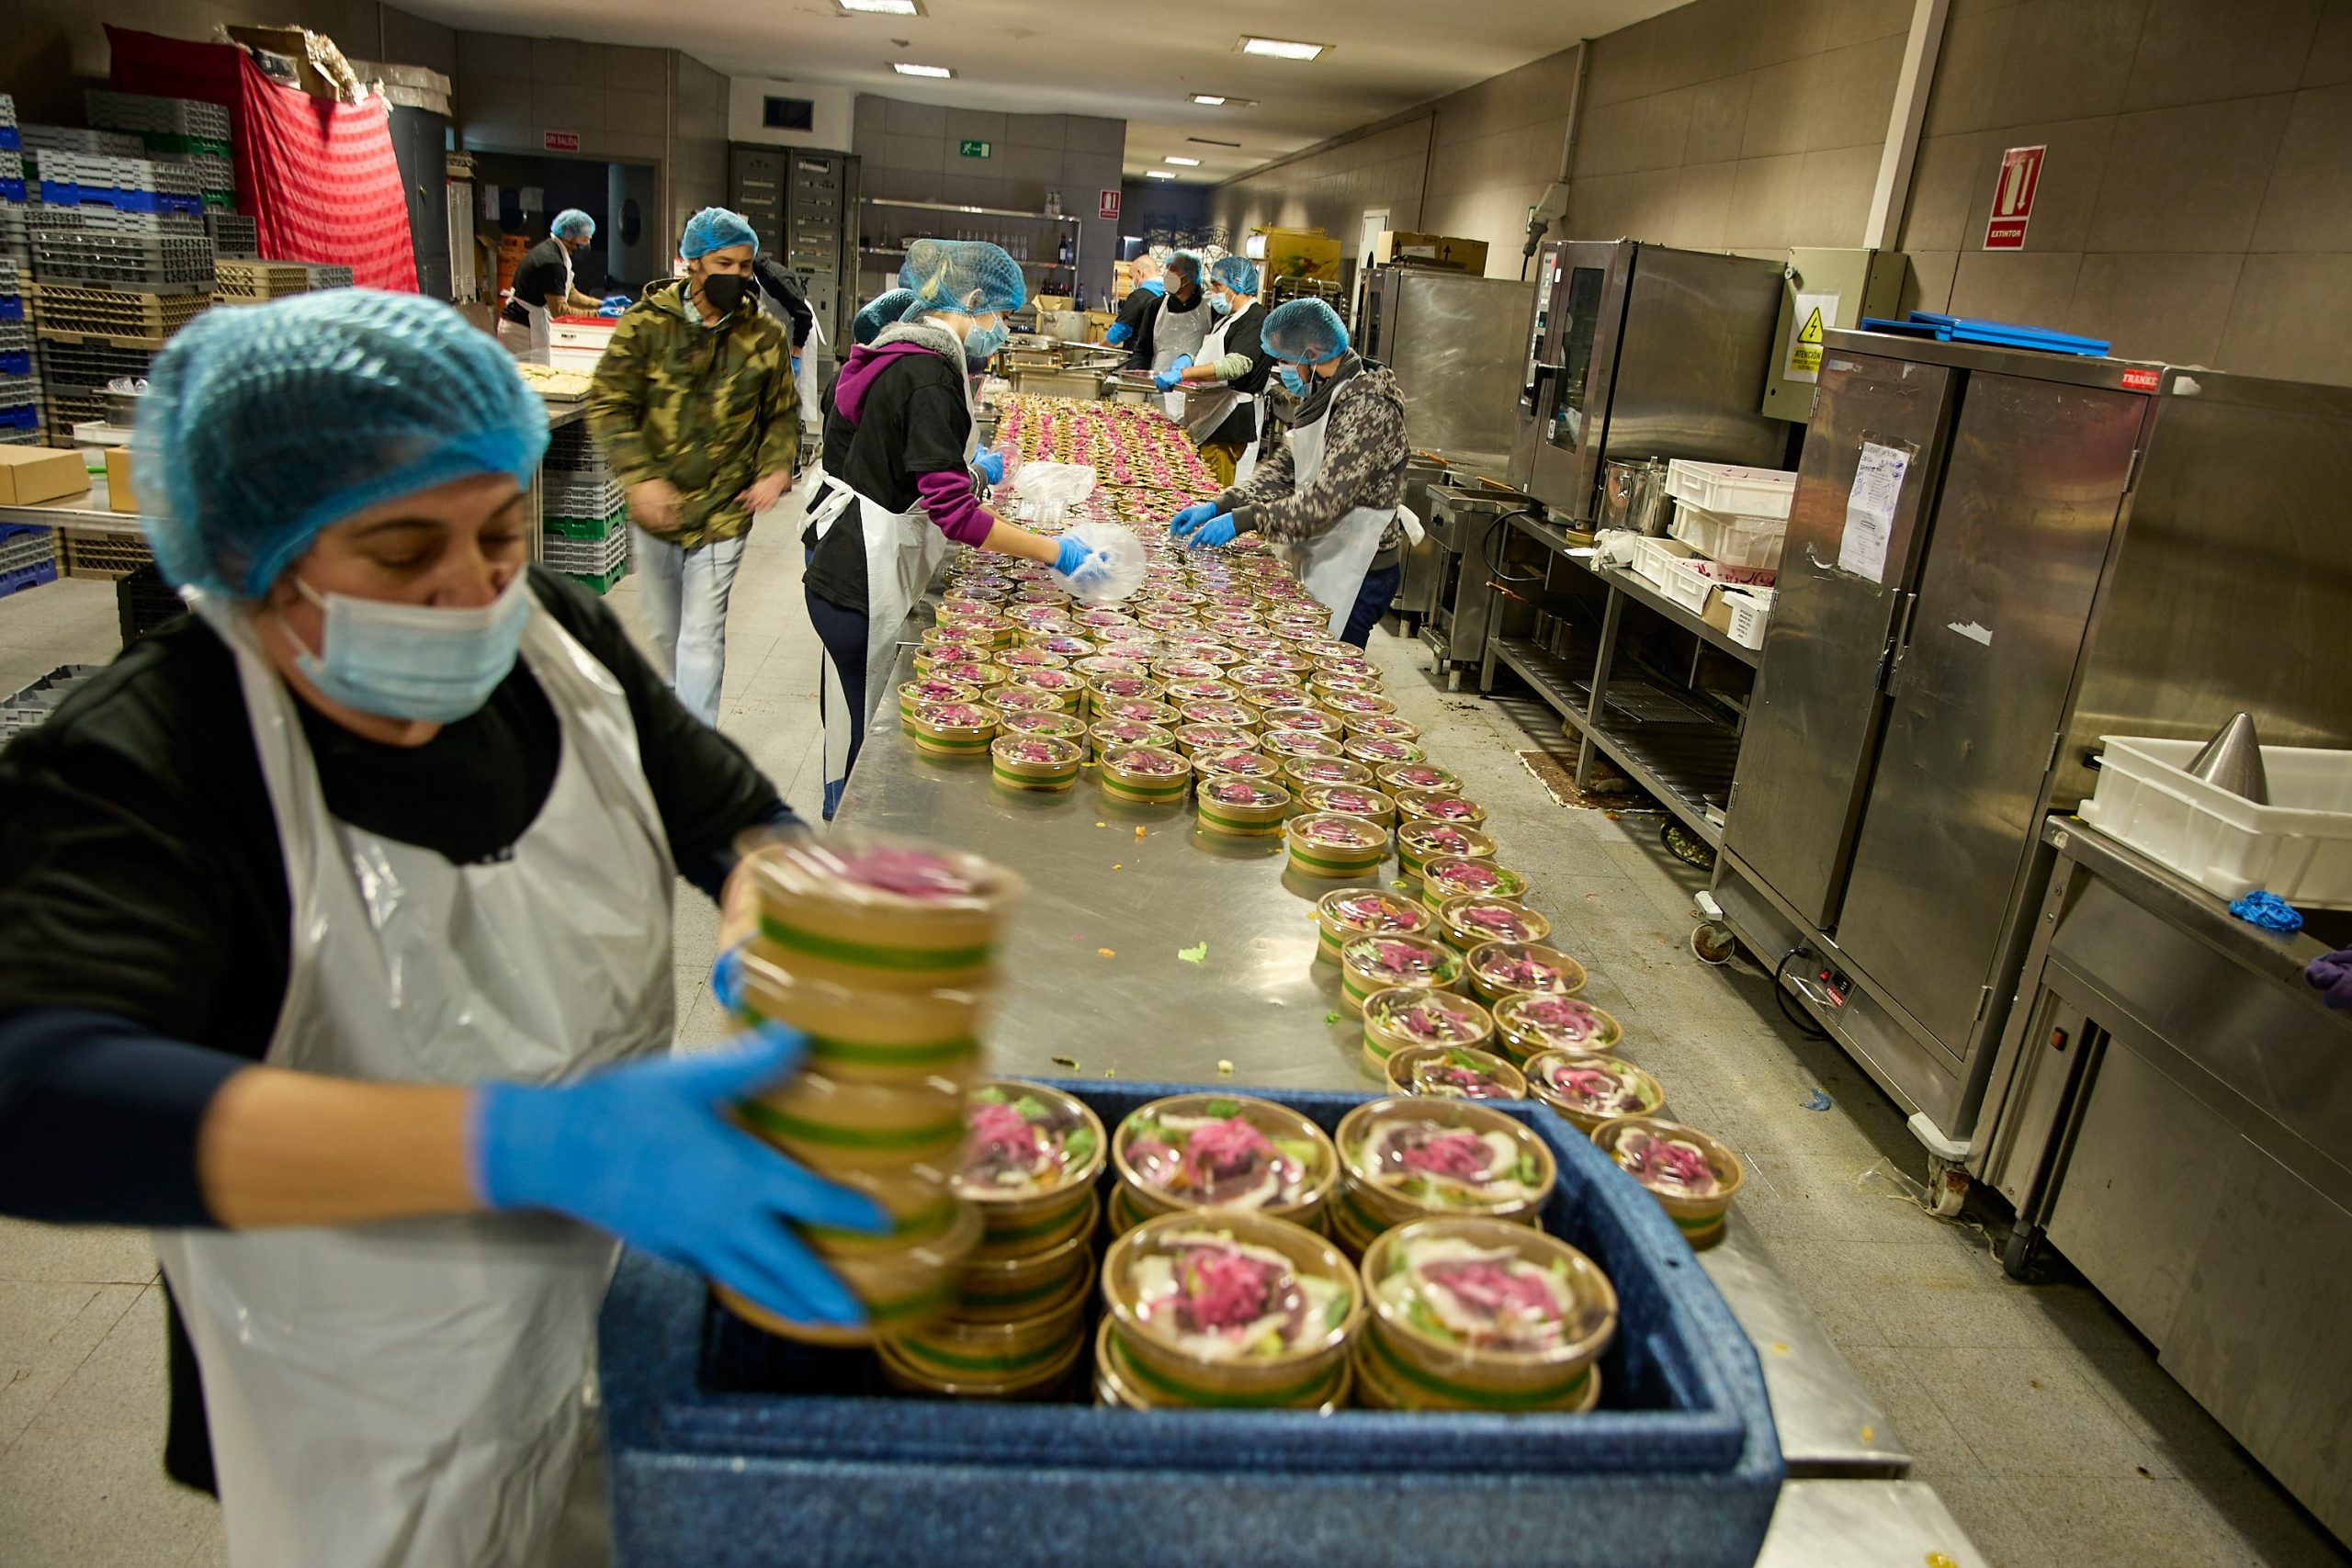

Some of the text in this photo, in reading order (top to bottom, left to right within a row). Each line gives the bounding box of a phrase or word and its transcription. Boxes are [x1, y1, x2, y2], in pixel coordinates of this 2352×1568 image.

[557, 135, 578, 146] SALIDA
[1991, 230, 2021, 238] EXTINTOR
[1794, 350, 1821, 359] ATENCIÓN
[2122, 374, 2158, 386] FRANKE
